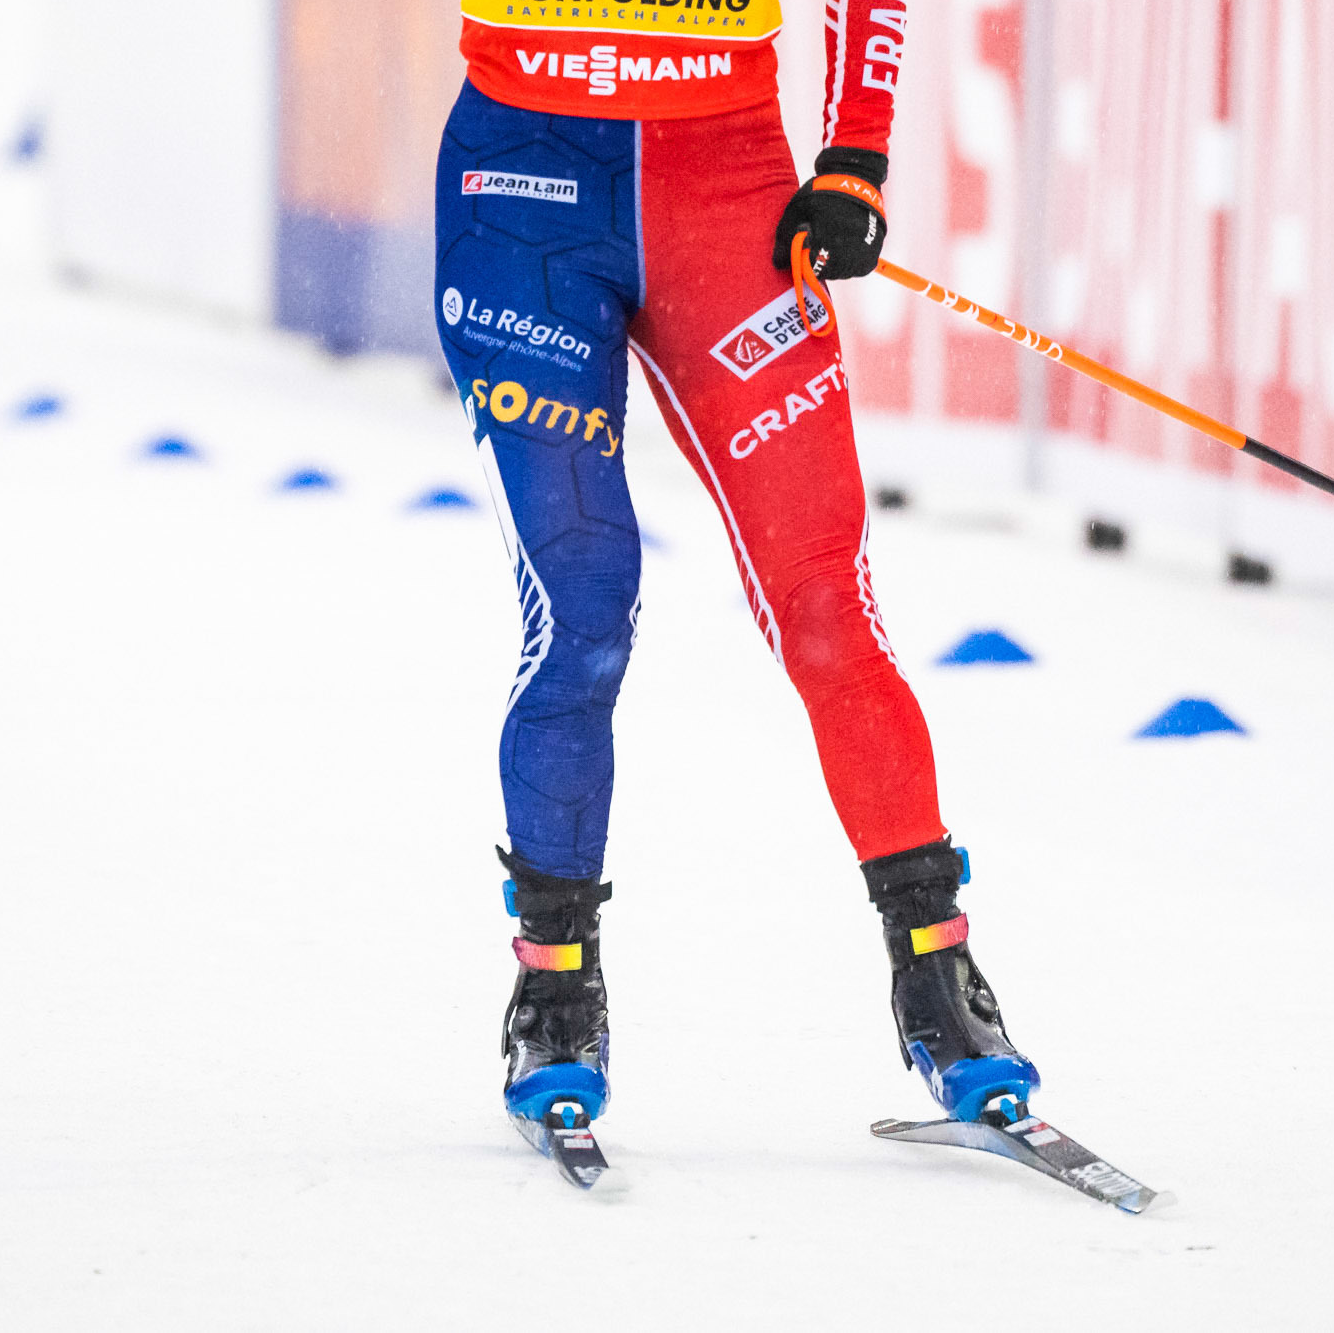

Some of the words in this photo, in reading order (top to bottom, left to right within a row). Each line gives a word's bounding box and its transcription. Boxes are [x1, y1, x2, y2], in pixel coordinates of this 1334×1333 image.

[506, 5, 659, 22] BAYERISCHE
[677, 14, 746, 27] ALPEN
[516, 45, 732, 97] VIESSMANN
[483, 176, 530, 189] Jean
[467, 298, 494, 327] La
[496, 308, 591, 360] Région
[763, 296, 814, 334] CAISE
[463, 325, 583, 373] Auvergne-Rhône-Alpes
[472, 378, 620, 457] somfy
[729, 363, 842, 460] CRAFT
